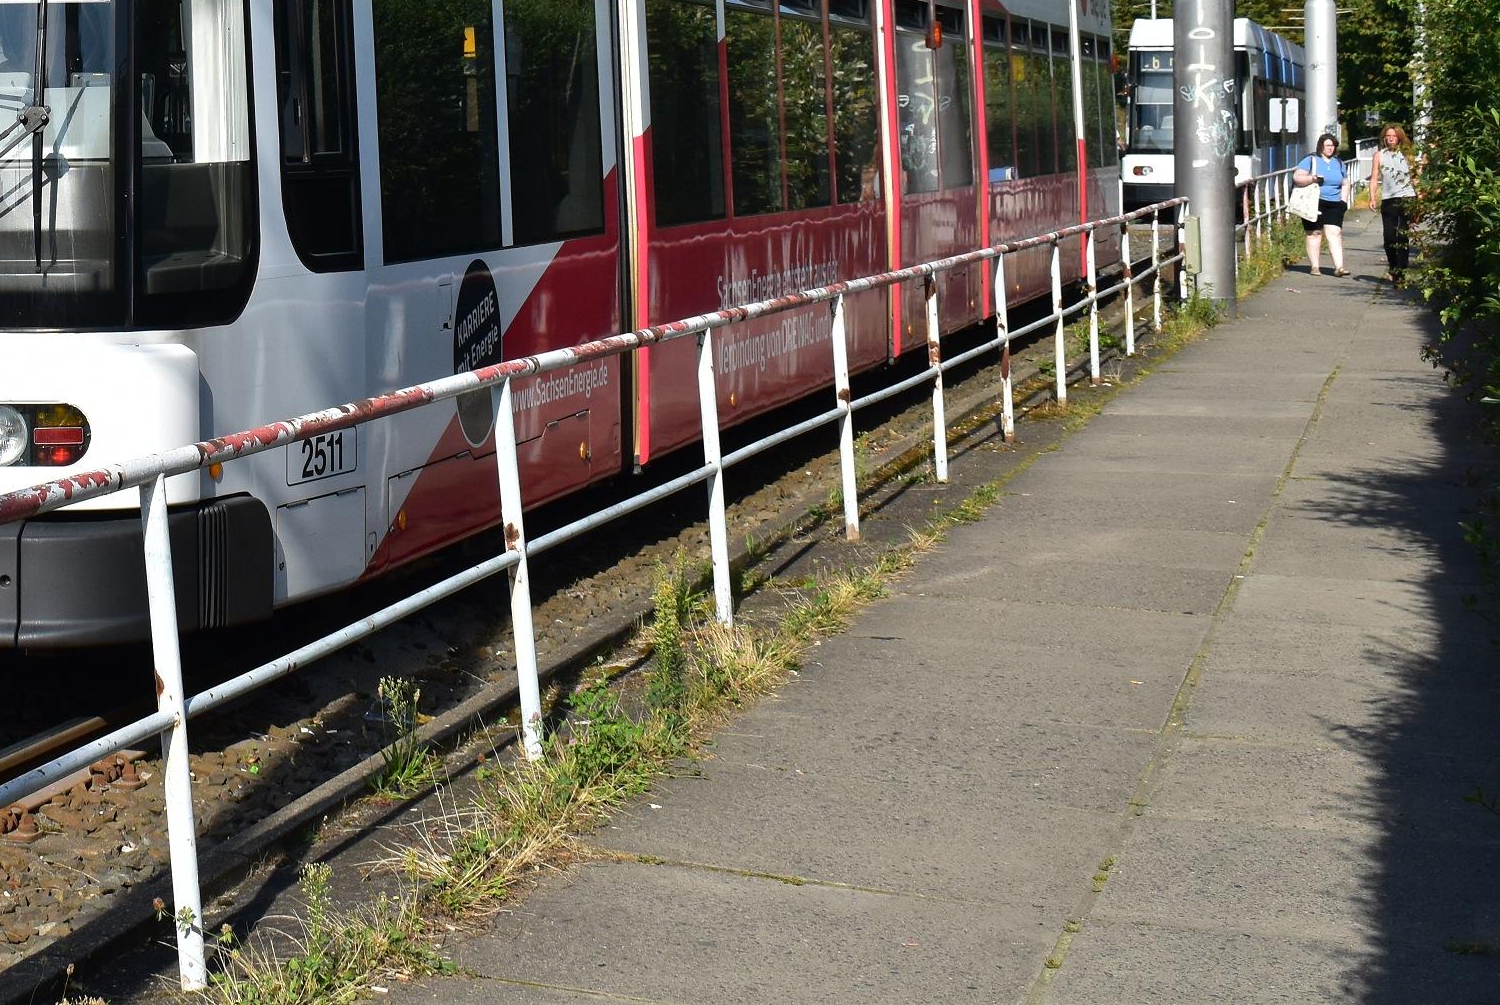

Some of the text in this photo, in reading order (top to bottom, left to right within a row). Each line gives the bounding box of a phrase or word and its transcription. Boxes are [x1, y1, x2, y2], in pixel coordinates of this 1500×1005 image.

[457, 291, 495, 348] KARRIERE
[718, 328, 766, 374] Verbindung
[766, 331, 781, 358] von
[781, 312, 815, 353] DREWAG
[470, 323, 499, 369] Energie
[511, 363, 608, 412] www.SachsenEnergie.de
[301, 432, 343, 479] 2511
